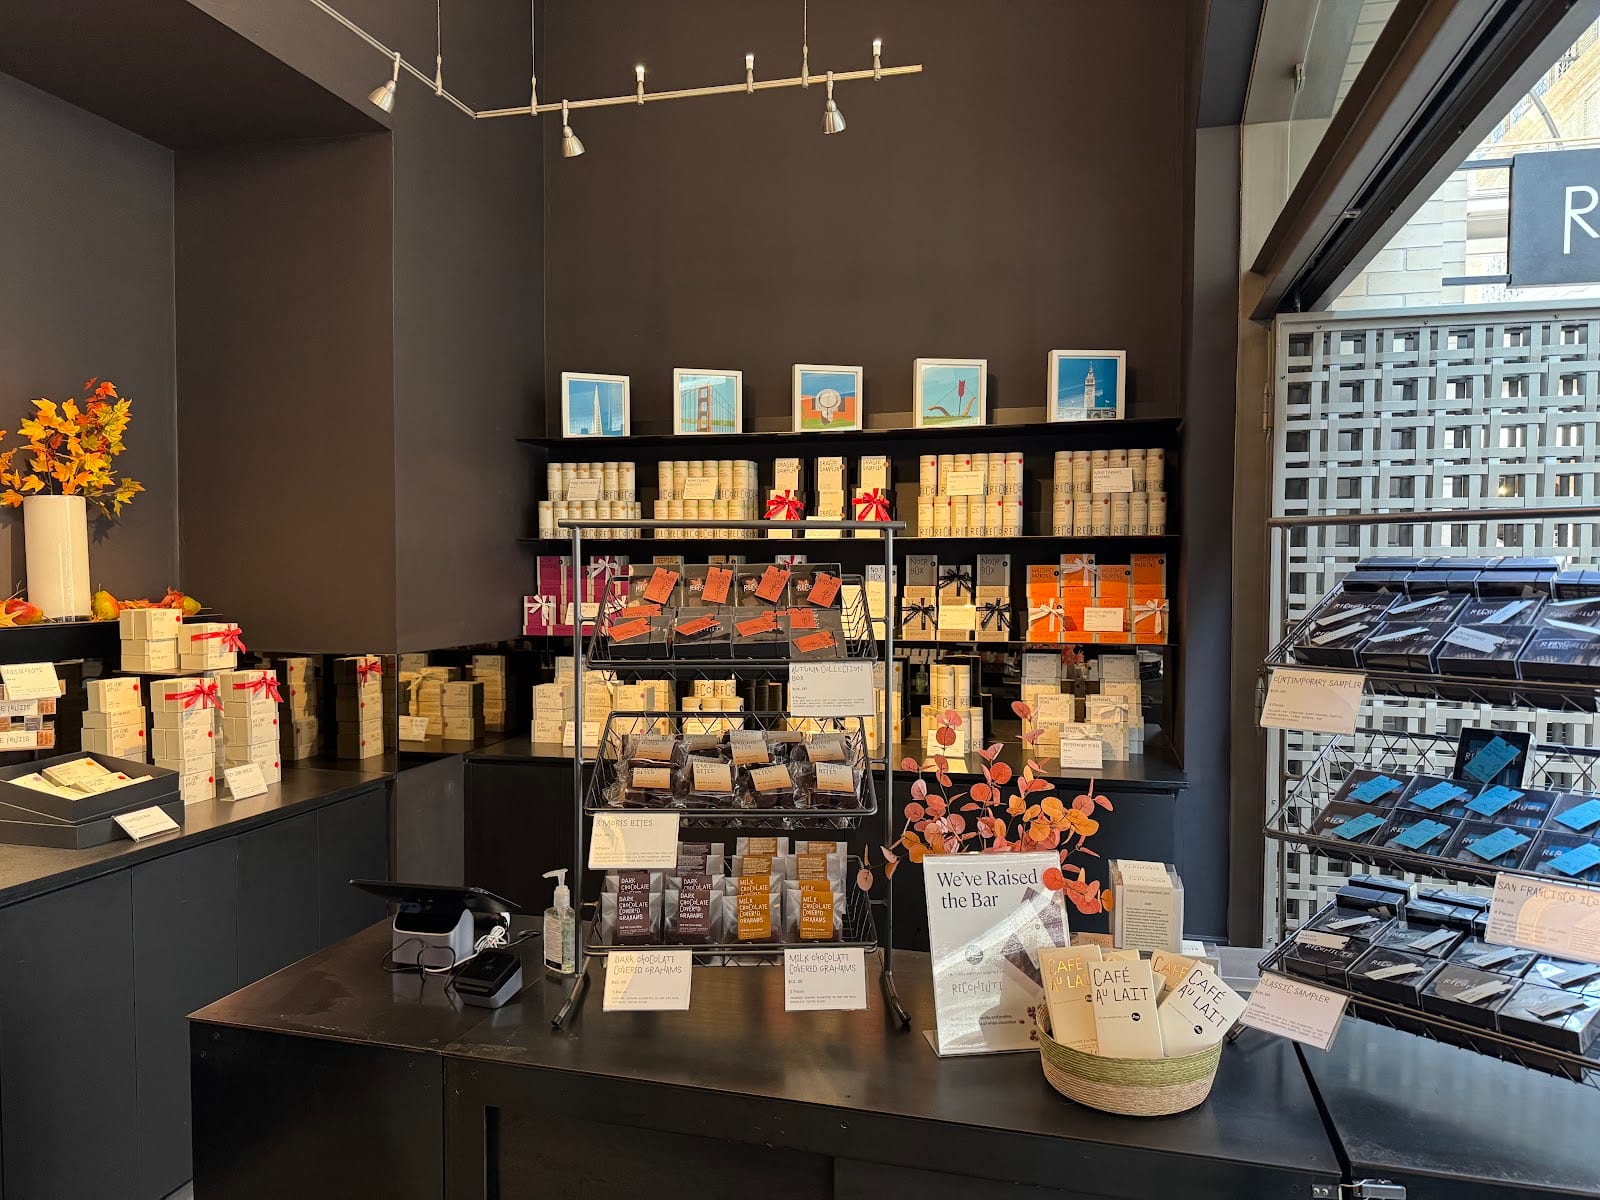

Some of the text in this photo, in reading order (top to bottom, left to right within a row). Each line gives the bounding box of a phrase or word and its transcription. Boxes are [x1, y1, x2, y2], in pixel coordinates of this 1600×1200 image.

[792, 665, 863, 674] AUTUMN COLLECTION
[1329, 679, 1362, 689] SAMPLER
[595, 818, 653, 828] S'MORES BITES
[936, 868, 1038, 888] We've Raised
[620, 883, 650, 891] CHOCOLATE
[740, 884, 769, 892] CHOCOLATE
[1497, 880, 1517, 893] SAN
[1520, 885, 1576, 904] FRANCISCO
[619, 902, 649, 910] CHOCOLATE
[680, 899, 709, 907] CHOCOLATE
[942, 892, 998, 909] the Bar
[619, 914, 644, 922] GRAHAMS
[614, 954, 676, 965] DARK CHOCOLATE
[789, 952, 849, 963] MILK CHOCOLATE
[613, 964, 682, 976] COVERED GRAHAMS
[789, 963, 857, 975] COVERED GRAHAMS
[1093, 966, 1131, 987] CAFÉ
[1188, 969, 1227, 1005] CAFÉ
[1261, 978, 1294, 994] CLASSIC
[1293, 987, 1330, 1004] SAMPLER
[1113, 987, 1149, 1002] LAIT
[1192, 996, 1228, 1028] LAIT
